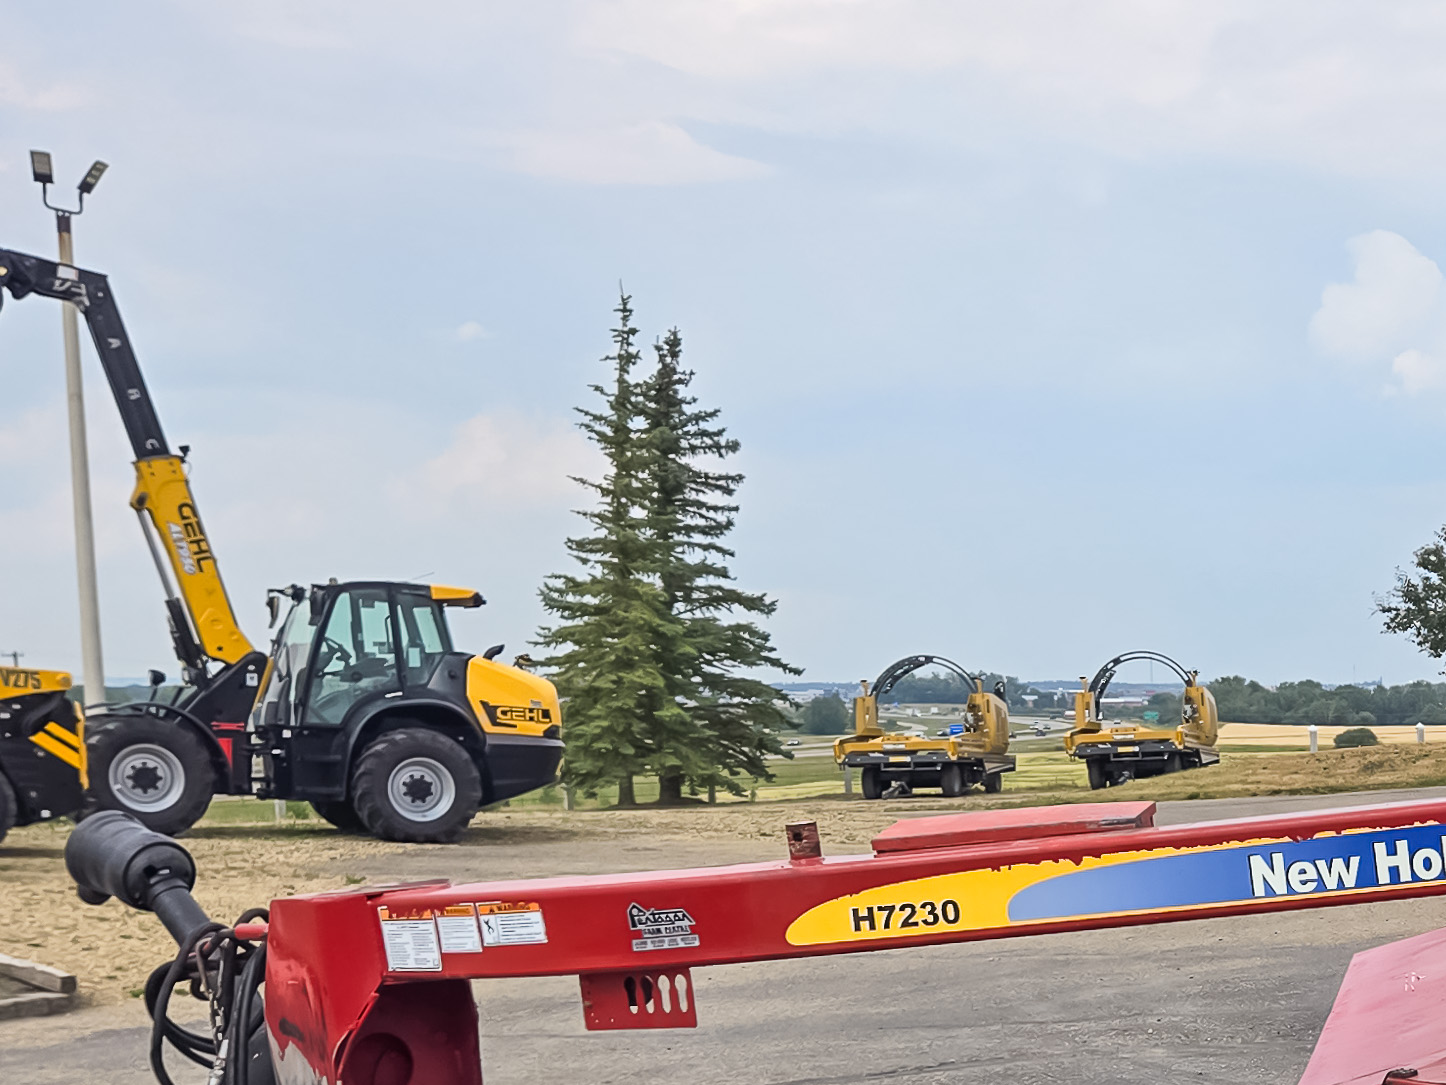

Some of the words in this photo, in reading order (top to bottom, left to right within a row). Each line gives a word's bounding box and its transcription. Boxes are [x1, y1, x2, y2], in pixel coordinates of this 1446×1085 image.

[178, 502, 213, 573] GEHL
[496, 707, 551, 724] GEHL
[1248, 852, 1360, 897] New
[851, 899, 960, 932] H7230
